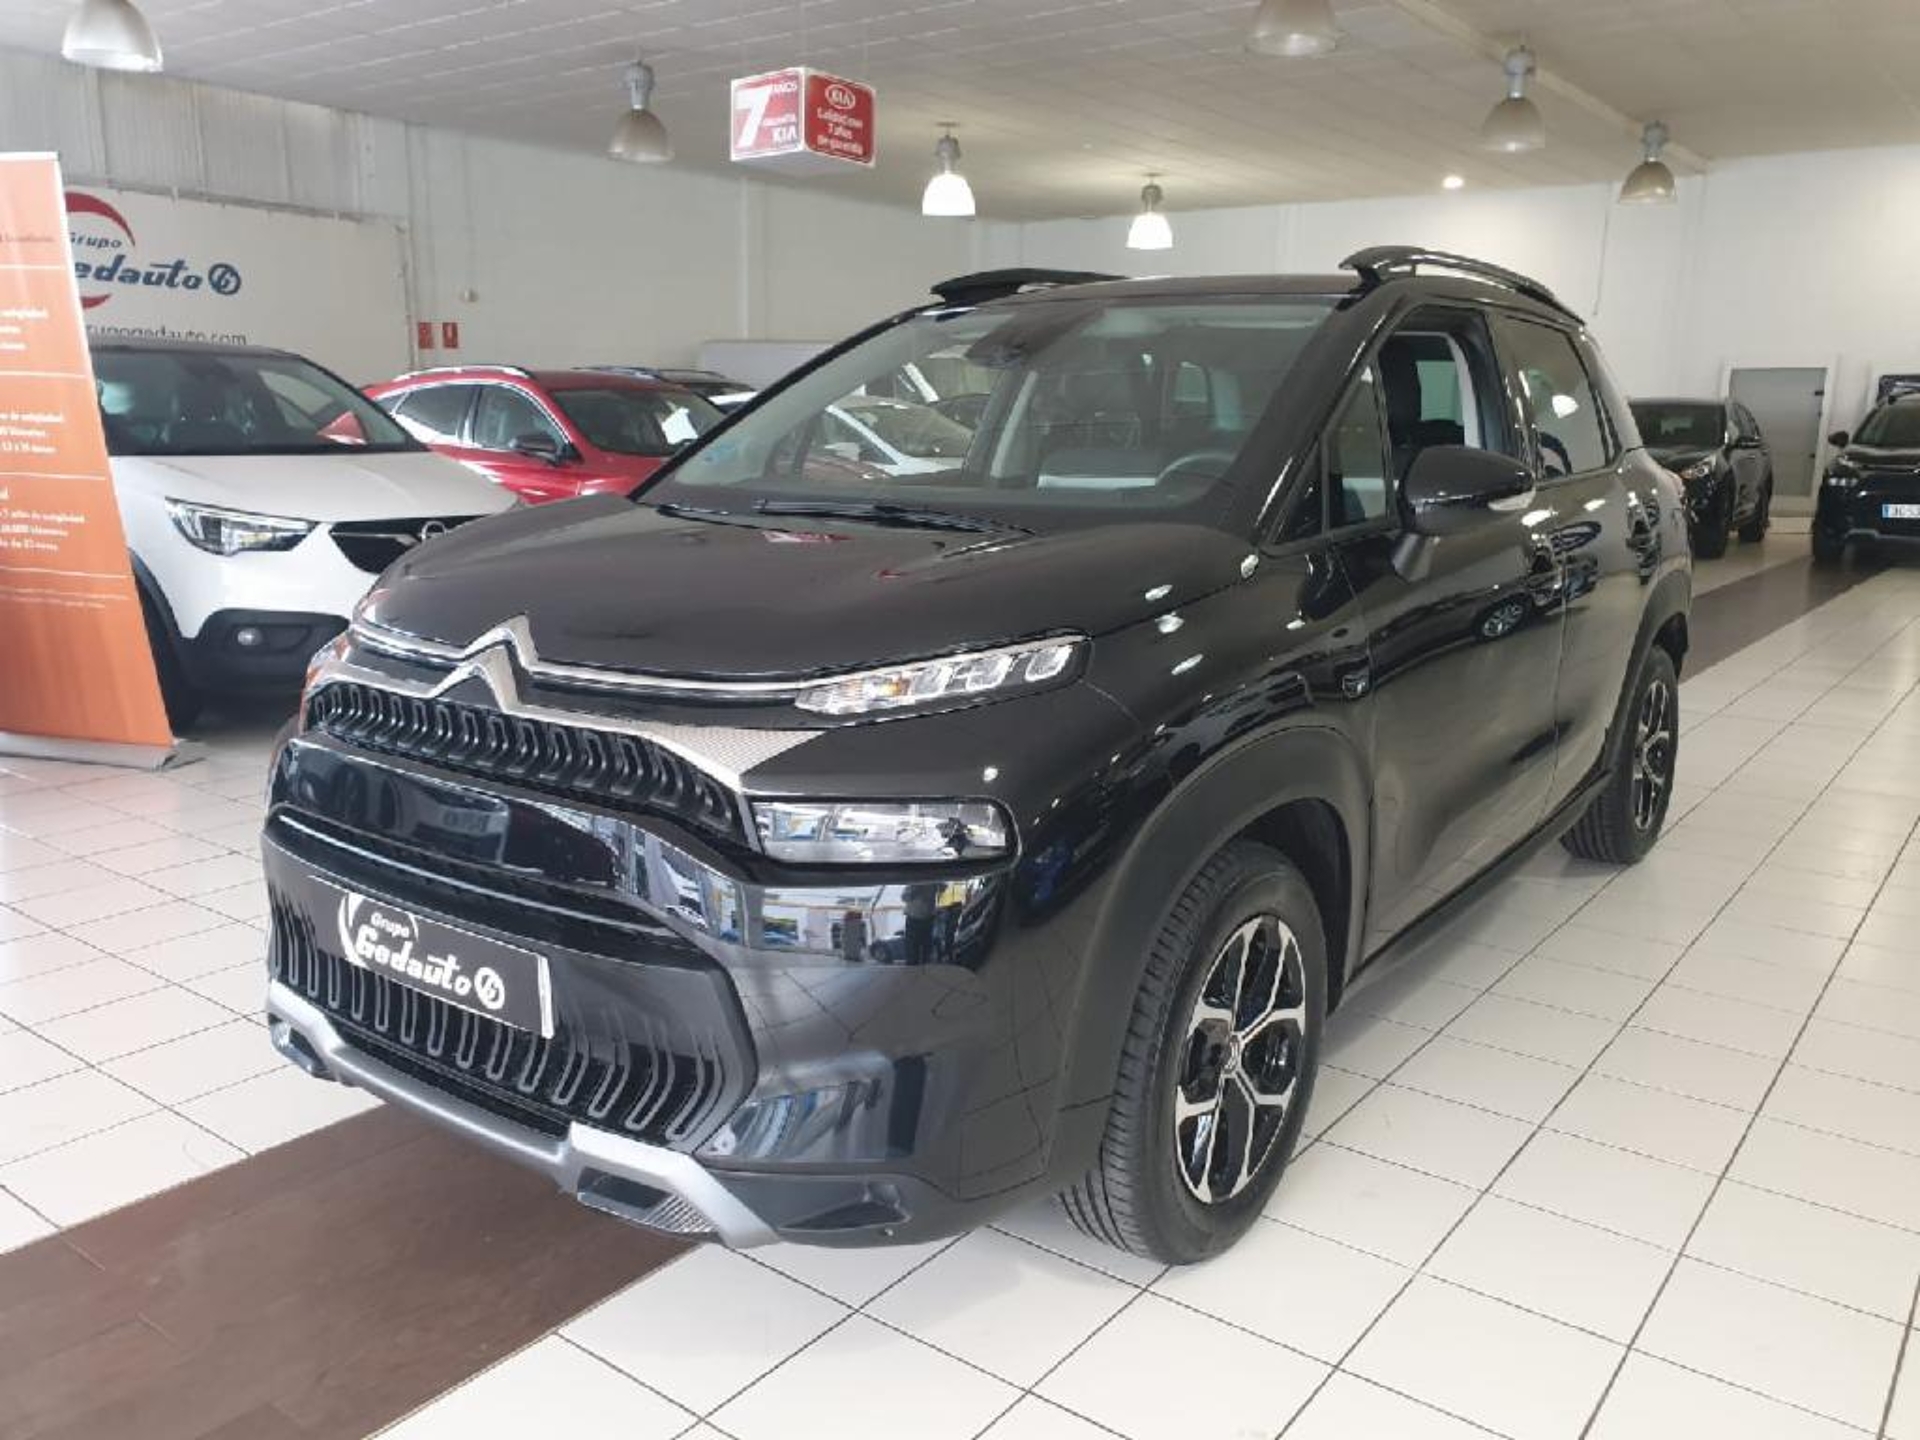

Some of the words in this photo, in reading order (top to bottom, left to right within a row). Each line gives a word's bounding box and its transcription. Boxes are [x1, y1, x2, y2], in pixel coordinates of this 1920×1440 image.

[831, 90, 851, 106] KIA
[735, 85, 772, 149] 7
[75, 254, 203, 290] edauto
[371, 912, 410, 938] Grupo
[355, 924, 472, 996] Gedauto
